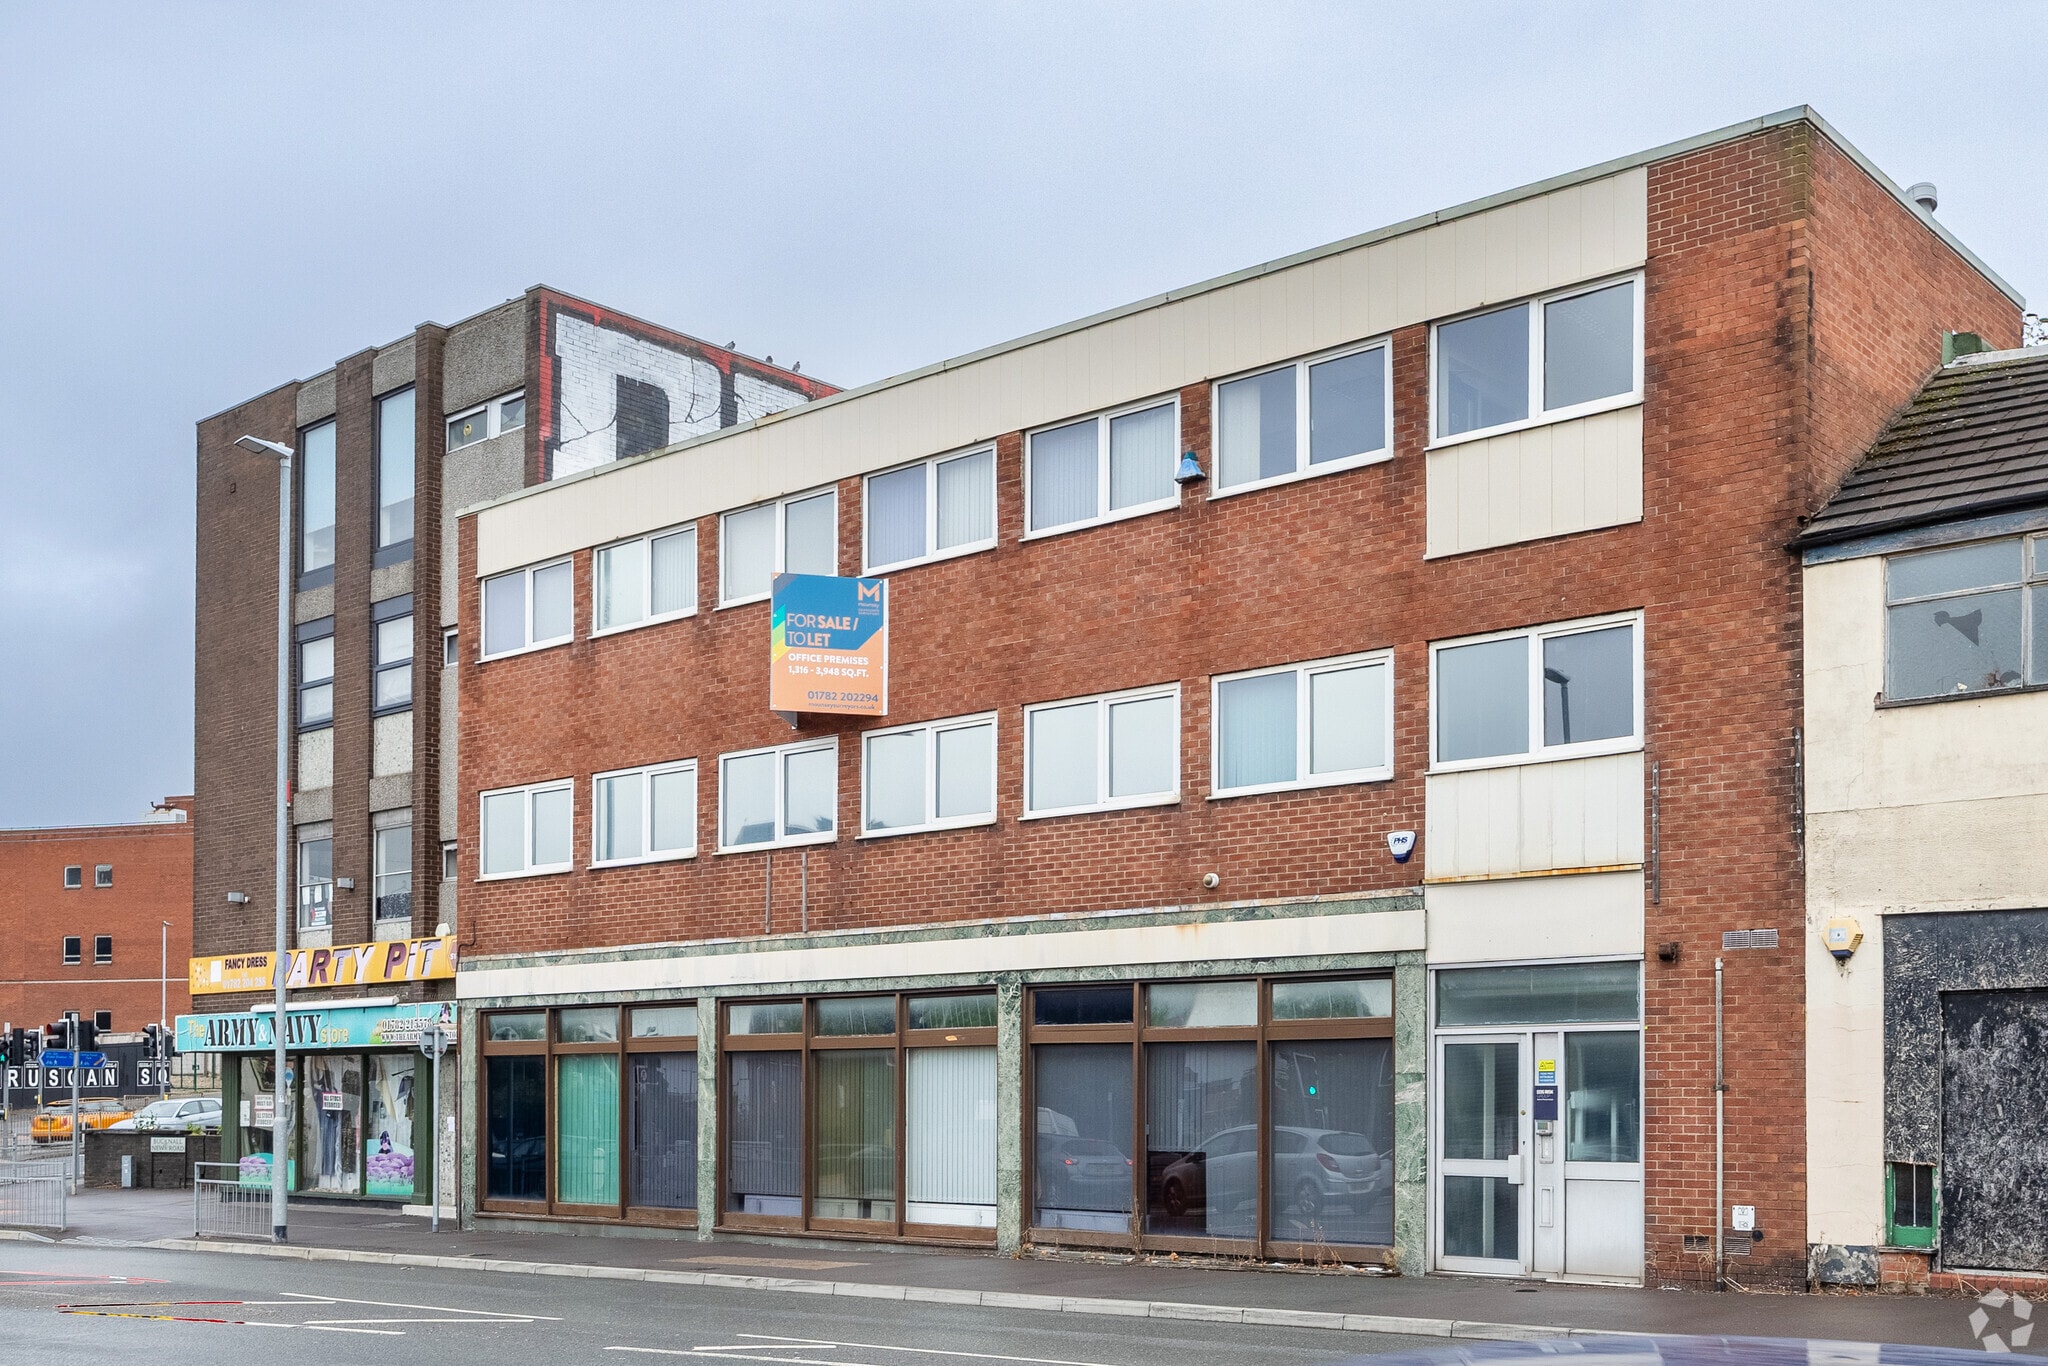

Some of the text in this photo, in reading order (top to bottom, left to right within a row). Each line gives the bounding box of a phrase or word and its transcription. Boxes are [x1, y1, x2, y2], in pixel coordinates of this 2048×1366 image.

[786, 613, 859, 631] FOR SALE /
[787, 631, 831, 647] TO LET
[788, 653, 869, 666] OFFICE PREMISES
[788, 665, 809, 675] 1,316
[815, 666, 840, 677] 3,948
[841, 668, 869, 679] SQ.FT.
[807, 690, 879, 703] 01782 202294
[224, 956, 267, 970] FANCY DRESS
[188, 1020, 205, 1039] The
[204, 1018, 259, 1046] ARMY
[259, 1023, 267, 1043] &
